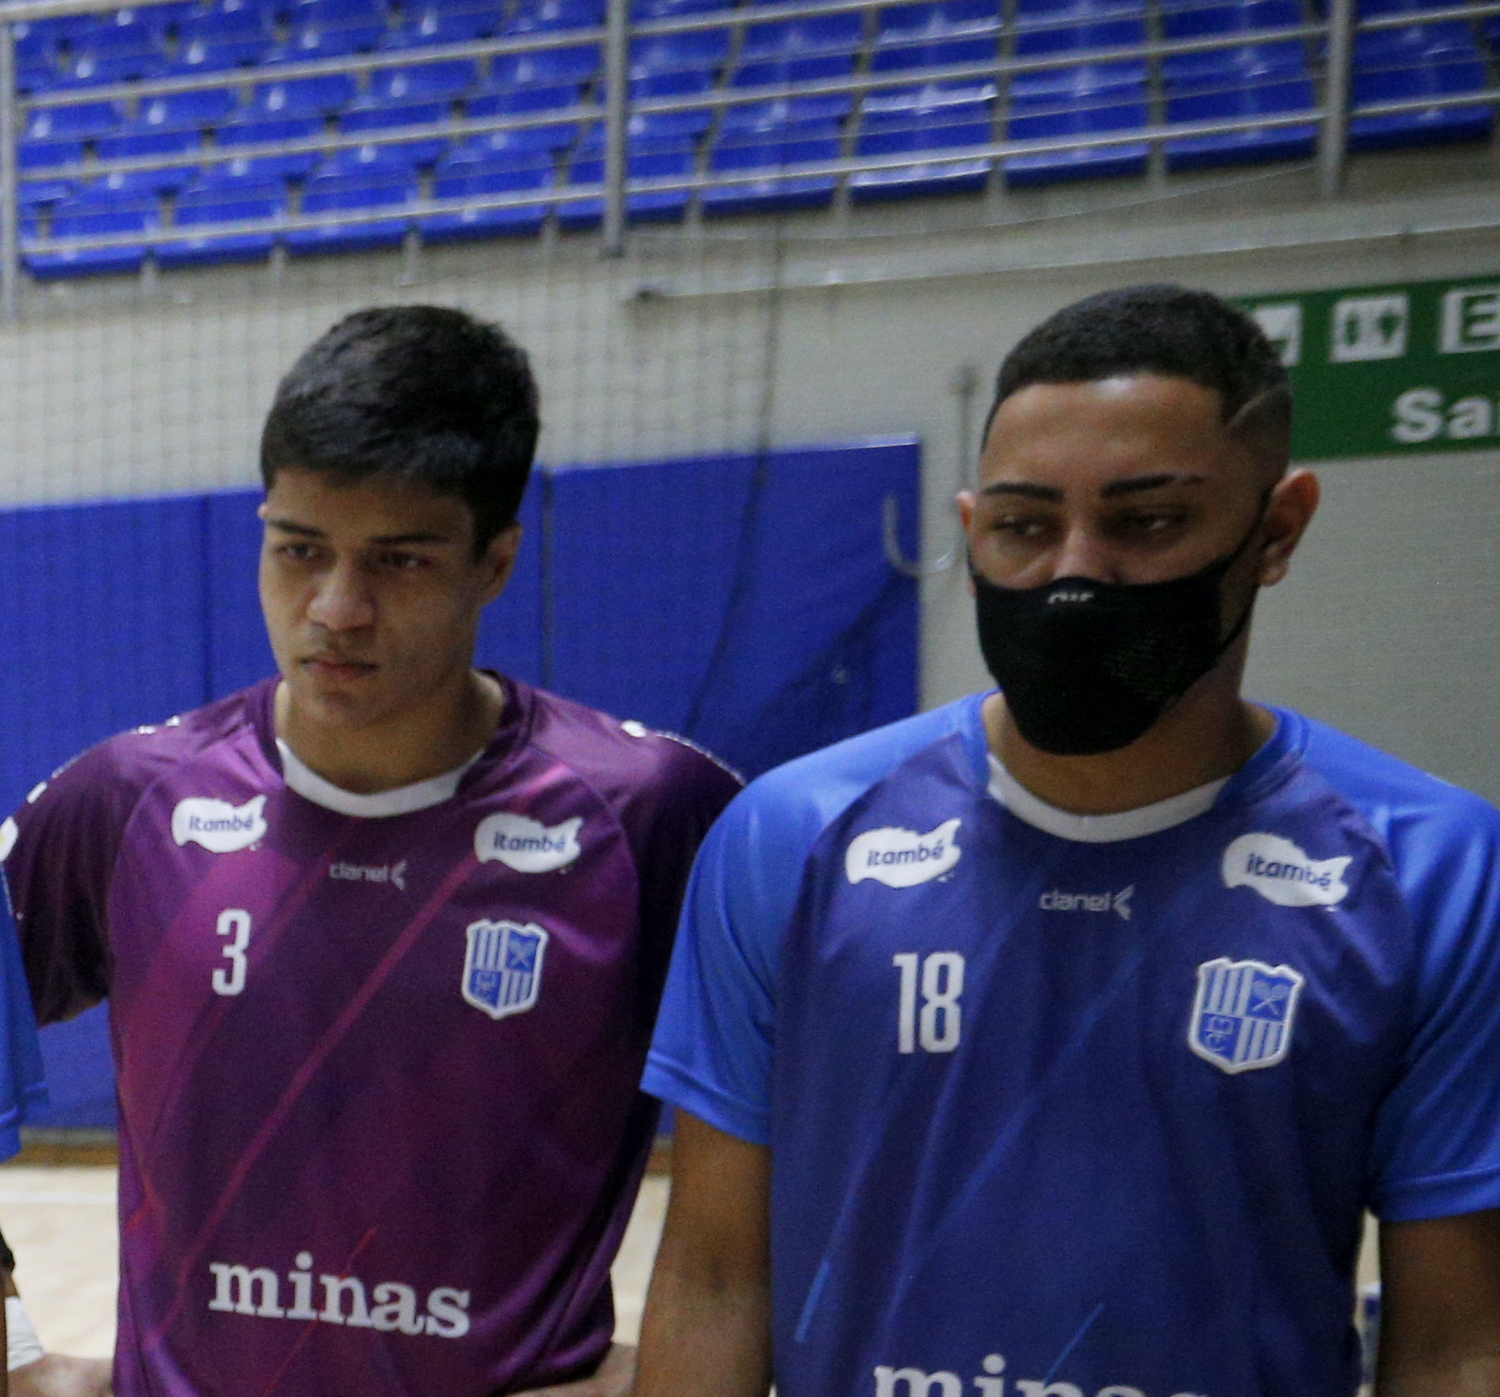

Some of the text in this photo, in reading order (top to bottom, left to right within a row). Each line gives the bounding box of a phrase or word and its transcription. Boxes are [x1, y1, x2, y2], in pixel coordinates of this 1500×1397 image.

[1393, 388, 1500, 442] Sa
[212, 909, 251, 996] 3
[892, 952, 965, 1054] 18
[208, 1251, 471, 1338] minas
